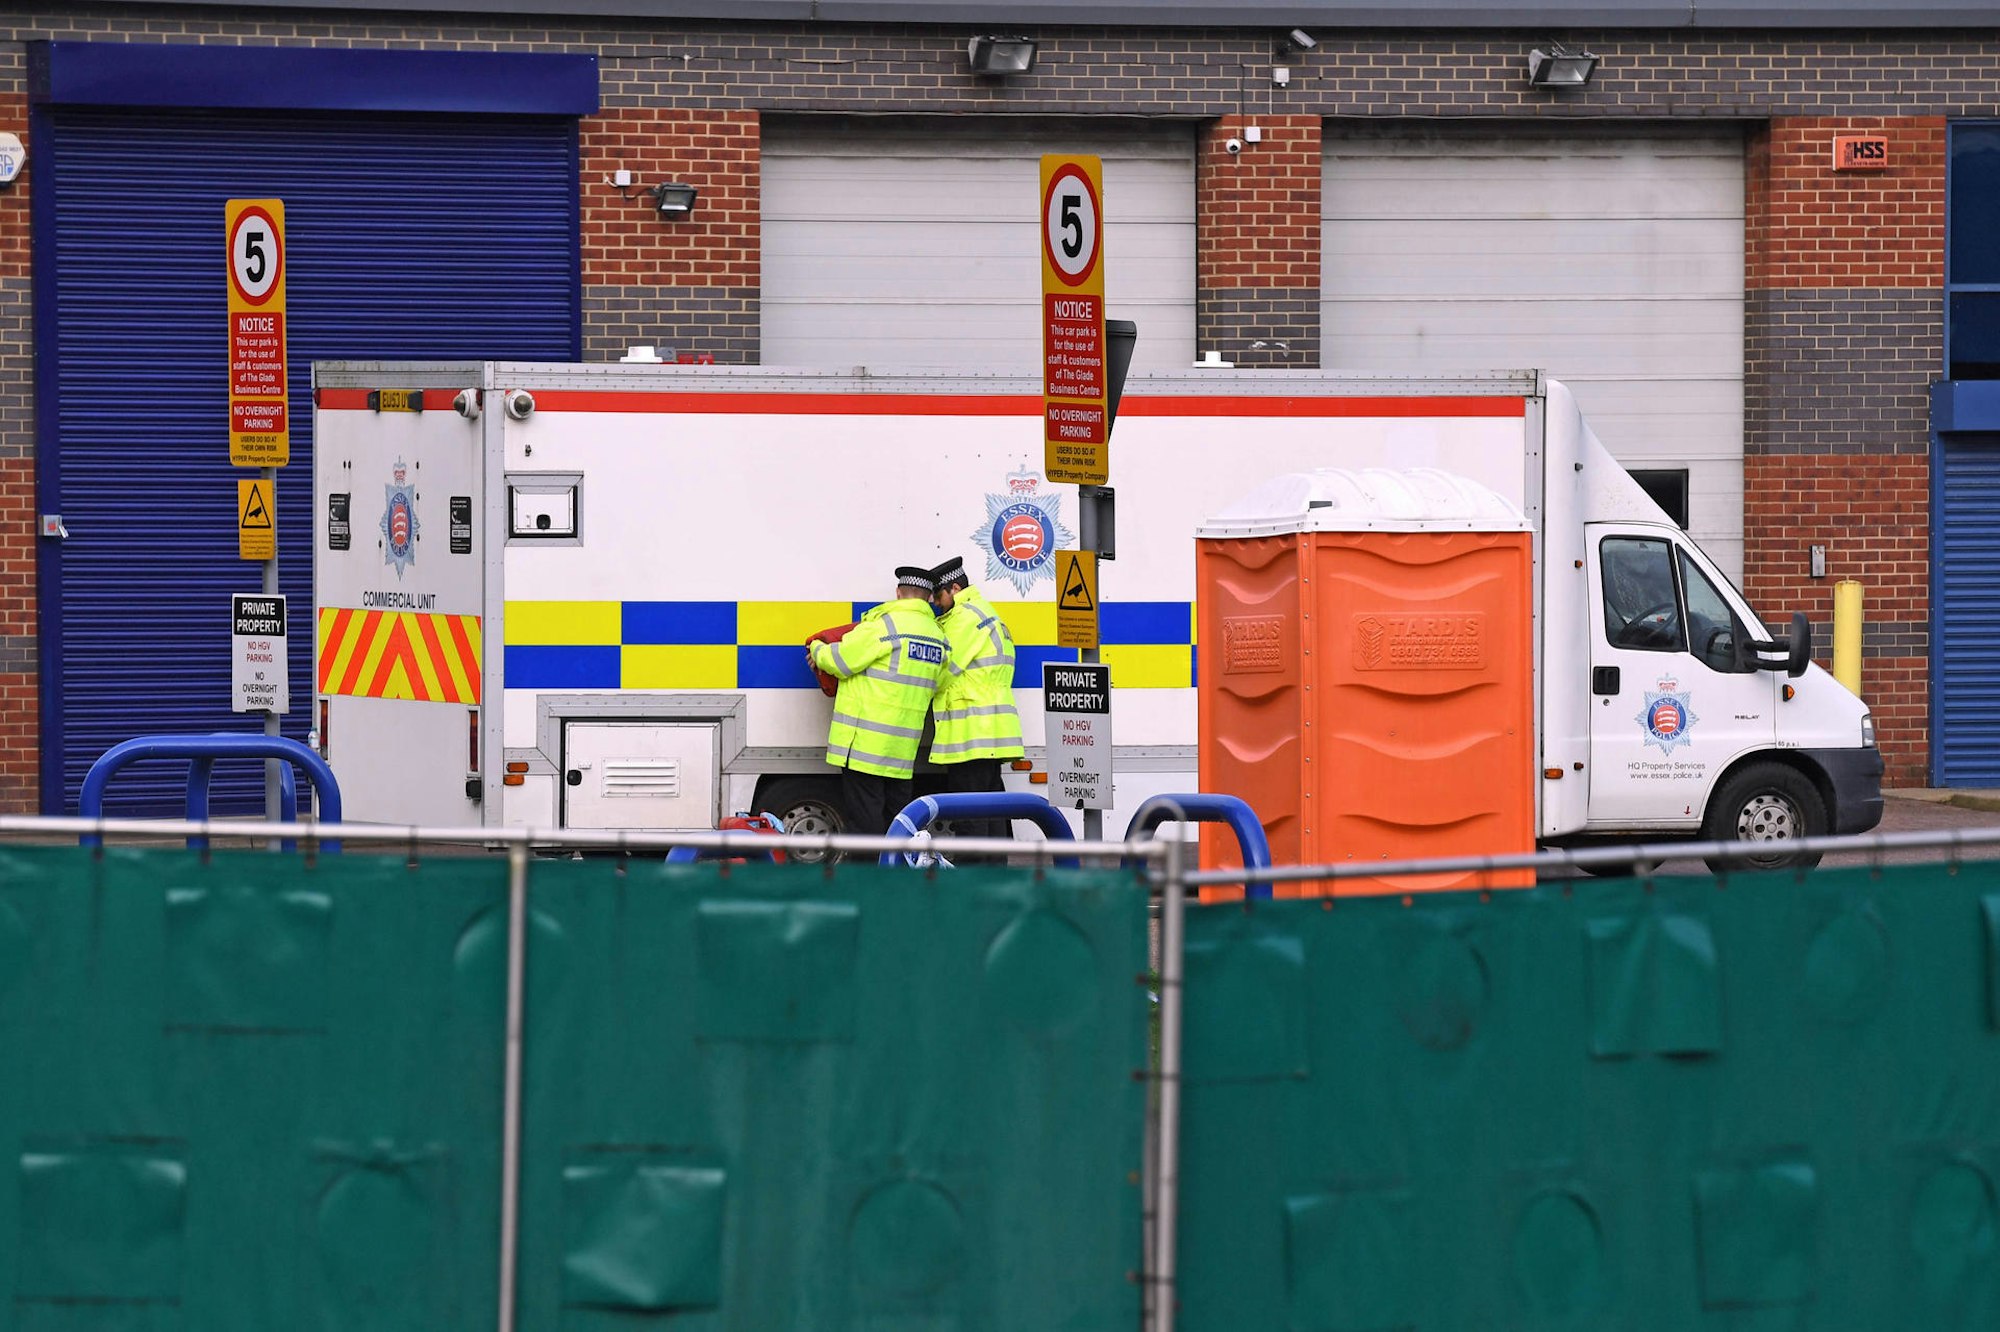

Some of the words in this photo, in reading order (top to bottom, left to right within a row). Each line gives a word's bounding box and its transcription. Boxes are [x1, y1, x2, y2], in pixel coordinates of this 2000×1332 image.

[1854, 142, 1884, 158] HSS
[1061, 195, 1082, 258] 5
[246, 232, 266, 282] 5
[1054, 300, 1092, 318] NOTICE
[239, 317, 274, 332] NOTICE
[1050, 324, 1064, 336] This
[1065, 327, 1075, 336] car
[1076, 327, 1090, 338] park
[1091, 327, 1096, 337] is
[236, 337, 248, 346] This
[259, 338, 272, 348] park
[273, 338, 278, 346] is
[1054, 339, 1063, 350] for
[1064, 340, 1073, 350] the
[1075, 342, 1086, 351] use
[1087, 341, 1094, 351] of
[239, 349, 247, 358] for
[248, 350, 257, 358] the
[269, 350, 276, 358] of
[233, 361, 246, 370] staff
[246, 361, 251, 370] &
[252, 362, 282, 370] customers
[1048, 354, 1062, 364] staff
[1063, 355, 1068, 364] &
[1069, 356, 1101, 366] customers
[240, 373, 246, 382] of
[247, 373, 258, 382] The
[259, 373, 275, 382] Glade
[1056, 369, 1062, 379] of
[1063, 369, 1074, 380] The
[1075, 370, 1094, 380] Glade
[234, 385, 261, 394] Business
[262, 385, 281, 394] Centre
[1050, 383, 1078, 394] Business
[1080, 384, 1100, 395] Centre
[233, 406, 244, 416] NO
[245, 406, 283, 416] OVERNIGHT
[1049, 409, 1060, 420] NO
[1061, 410, 1102, 423] OVERNIGHT
[244, 419, 273, 429] PARKING
[1060, 425, 1092, 438] PARKING
[248, 455, 266, 463] Property
[1057, 456, 1071, 464] THEIR
[1048, 469, 1063, 478] HYPER
[1064, 470, 1084, 480] Property
[1085, 472, 1106, 482] Company
[1001, 504, 1046, 522] ESSEX
[998, 550, 1049, 571] POLICE
[363, 591, 416, 608] COMMERCIAL
[418, 594, 436, 609] UNIT
[242, 602, 276, 615] PRIVATE
[237, 619, 281, 633] PROPERTY
[1235, 621, 1280, 640] TARDIS
[1389, 619, 1479, 636] TARDIS
[247, 642, 256, 650] NO
[258, 642, 271, 650] HGV
[246, 654, 273, 663] PARKING
[910, 644, 940, 662] POLICE
[255, 672, 264, 680] NO
[1055, 671, 1097, 688] PRIVATE
[242, 684, 278, 693] OVERNIGHT
[247, 696, 274, 706] PARKING
[1049, 692, 1104, 709] PROPERTY
[1064, 720, 1074, 730] NO
[1076, 720, 1091, 731] HGV
[1062, 735, 1094, 746] PARKING
[1074, 758, 1084, 768] NO
[1628, 762, 1640, 770] HQ
[1642, 762, 1672, 771] Property
[1059, 772, 1100, 784] OVERNIGHT
[1064, 788, 1096, 799] PARKING
